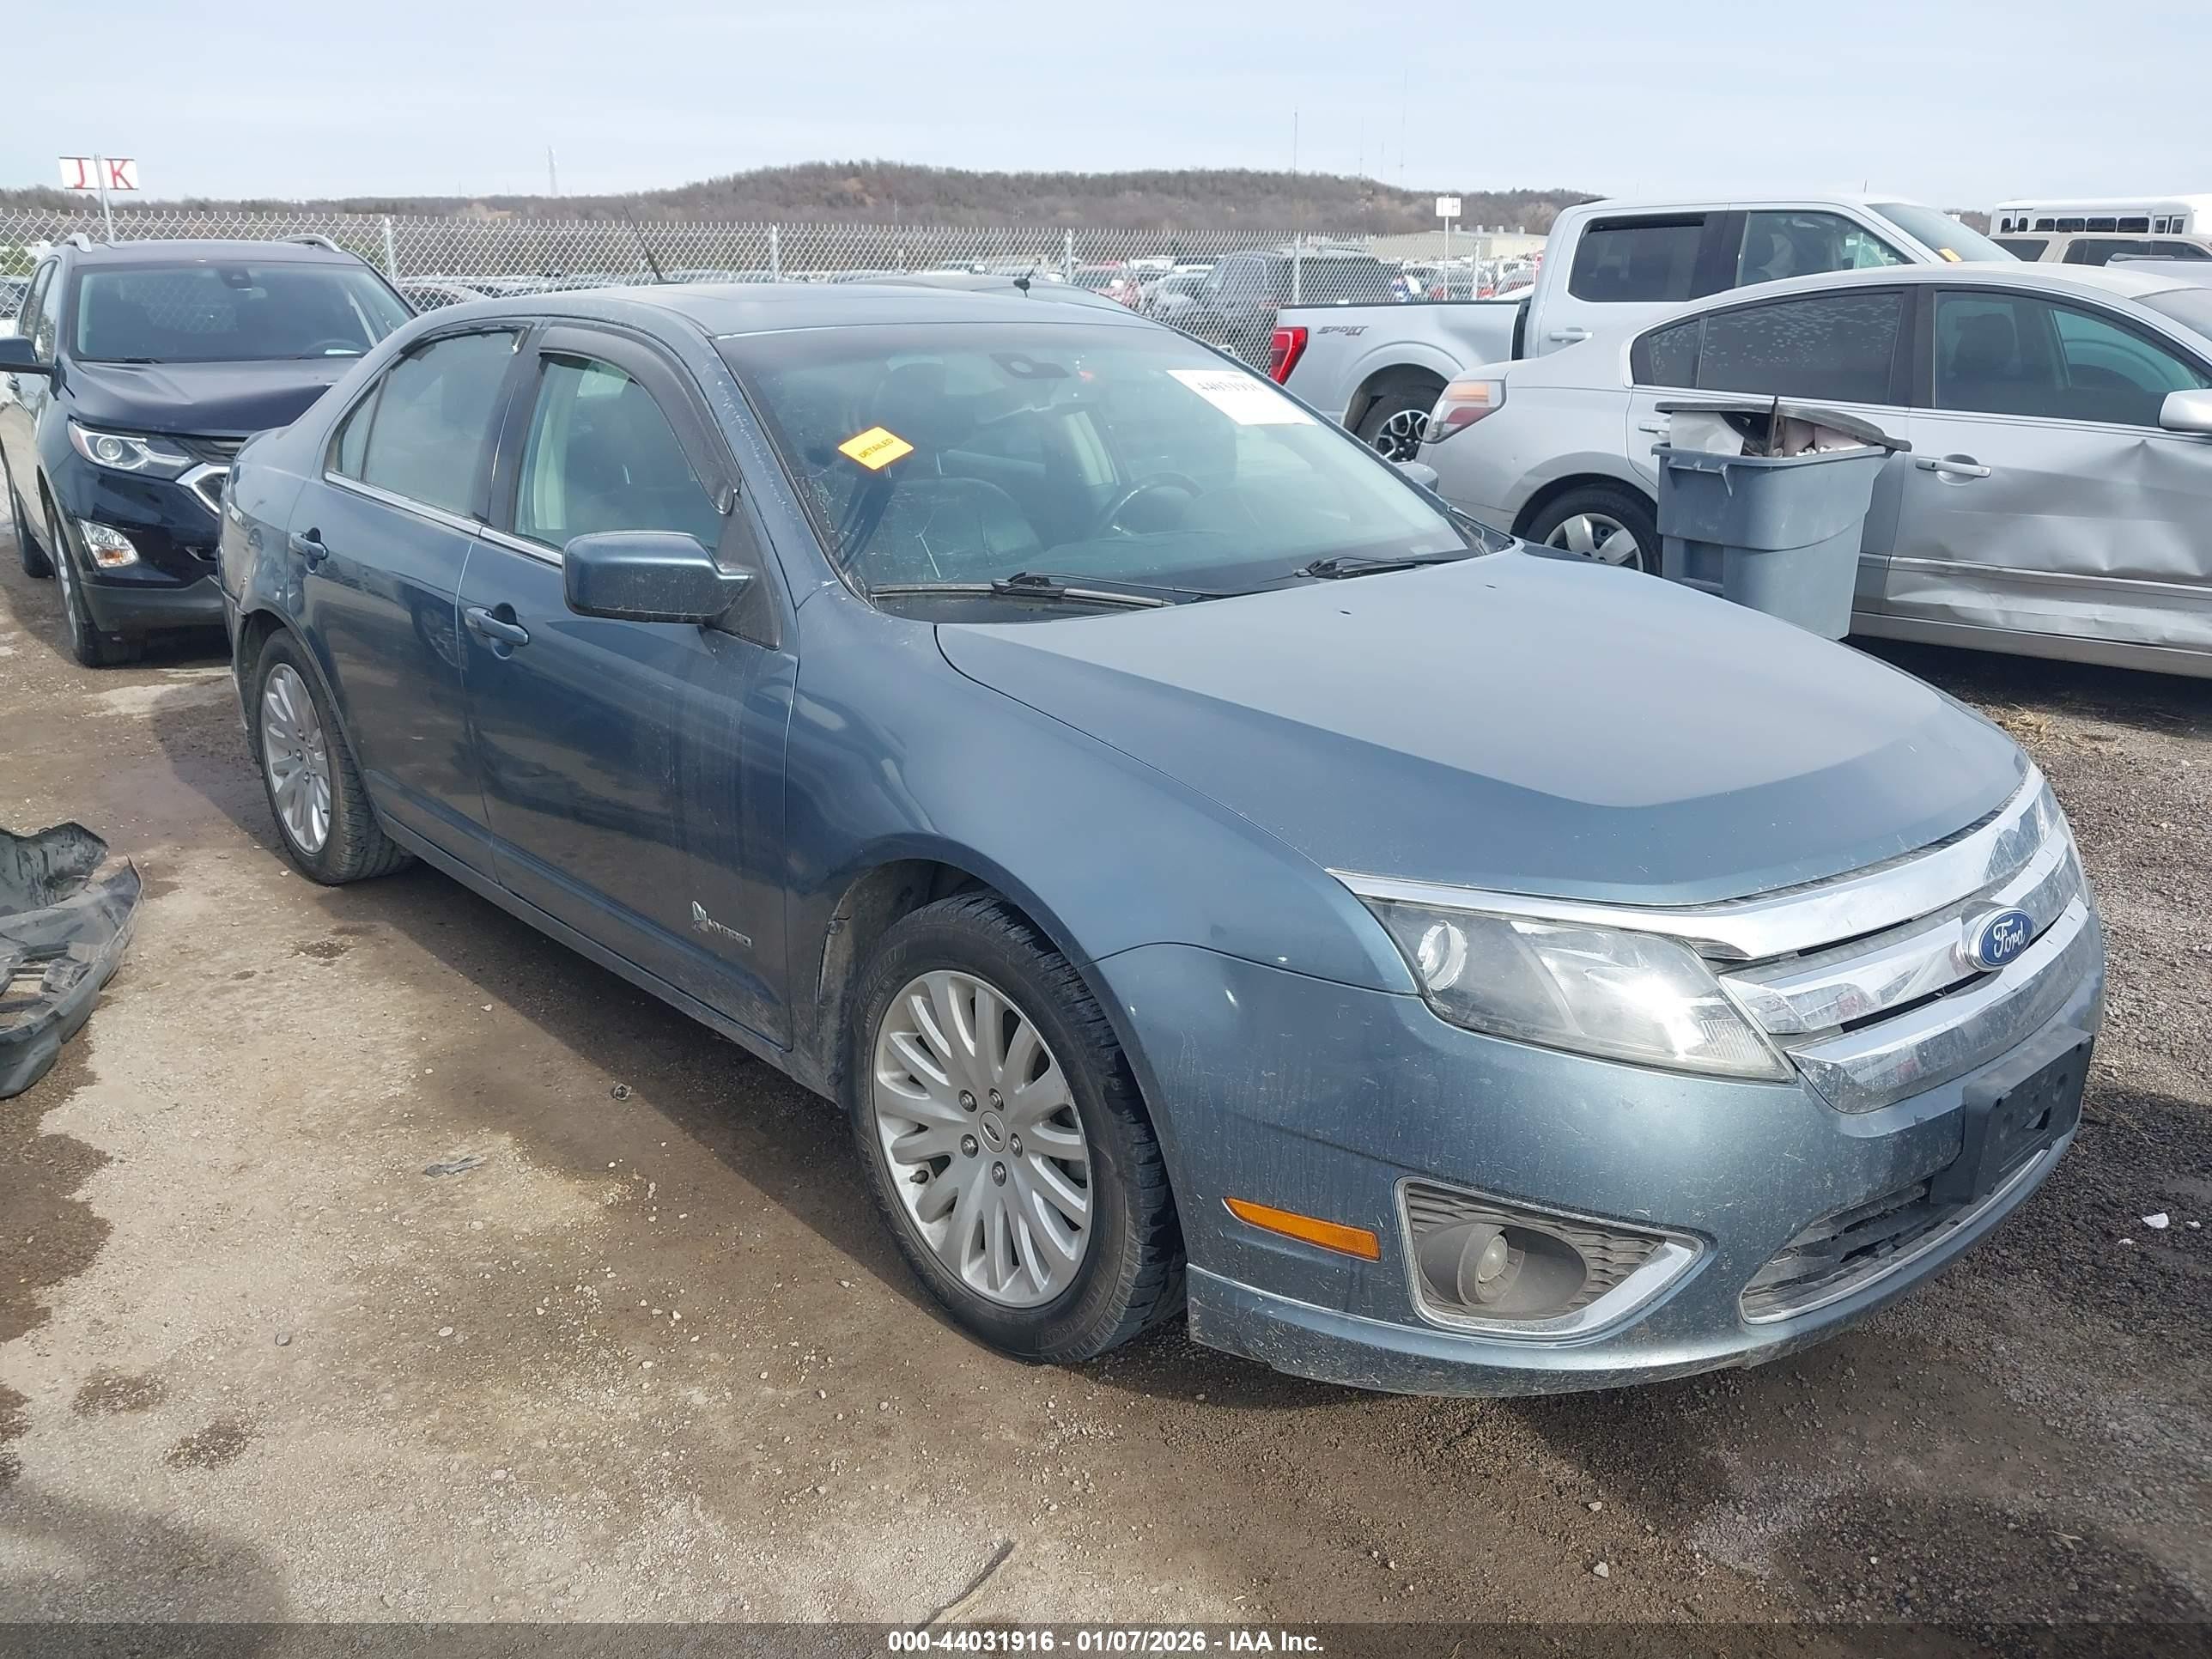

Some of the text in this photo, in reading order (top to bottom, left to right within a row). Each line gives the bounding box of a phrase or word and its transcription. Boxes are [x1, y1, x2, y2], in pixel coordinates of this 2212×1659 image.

[73, 158, 85, 189] J
[109, 159, 134, 189] K
[858, 438, 894, 459] DETAILED
[1992, 919, 2026, 958] Ford
